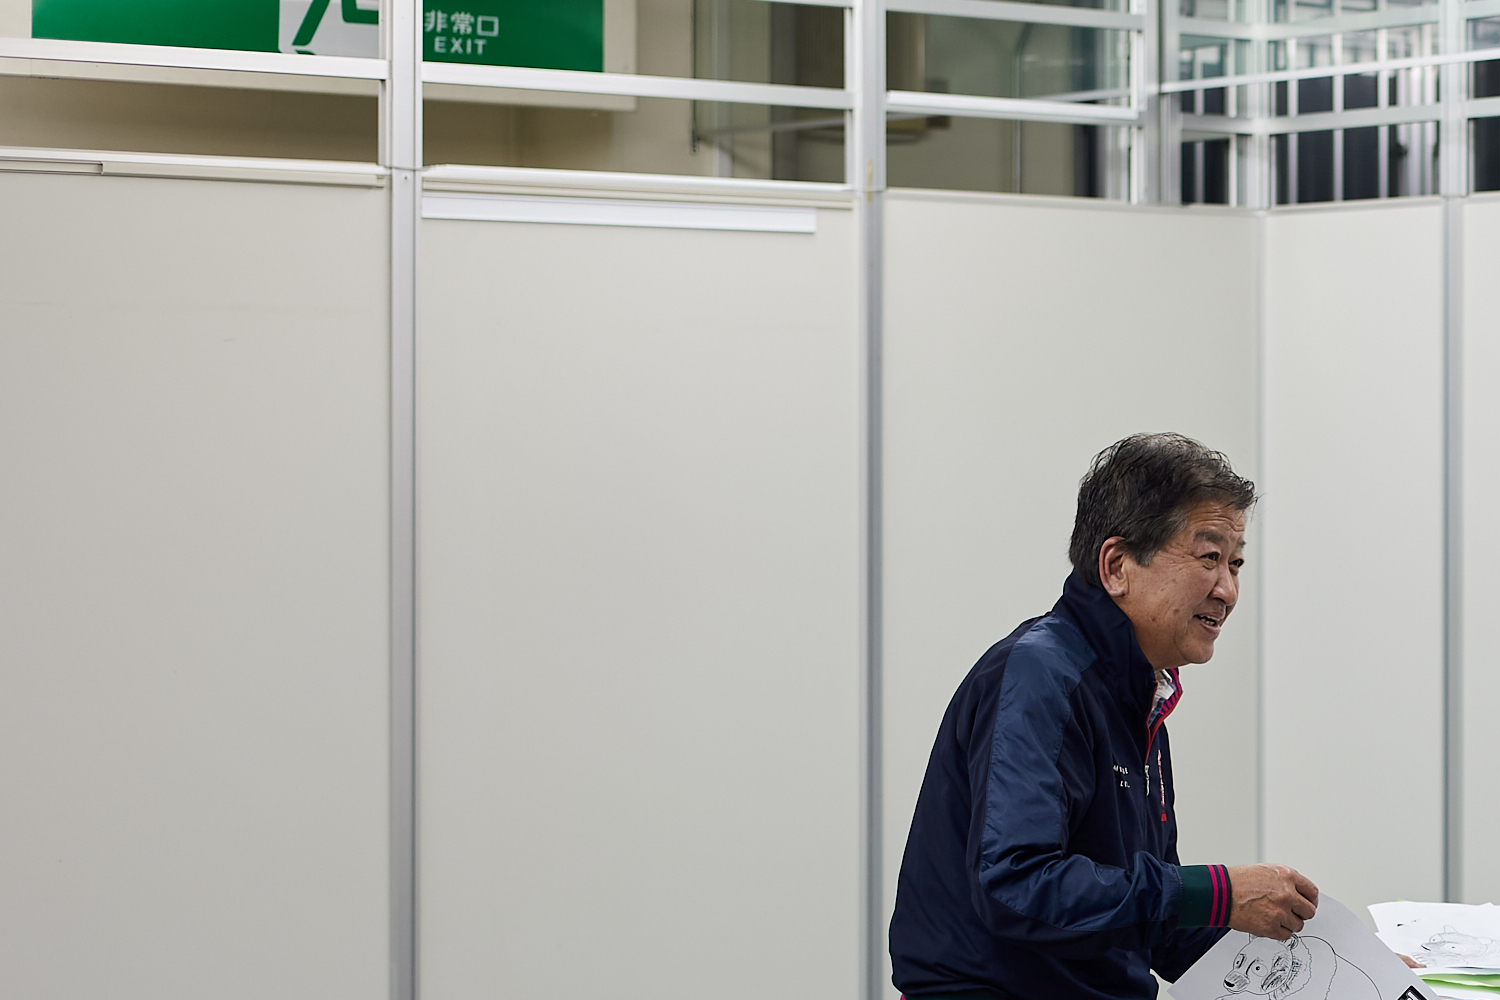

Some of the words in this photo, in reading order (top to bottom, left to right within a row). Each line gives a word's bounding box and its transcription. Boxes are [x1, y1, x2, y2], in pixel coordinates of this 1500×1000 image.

[424, 10, 499, 37] 非常口
[434, 36, 487, 55] EXIT
